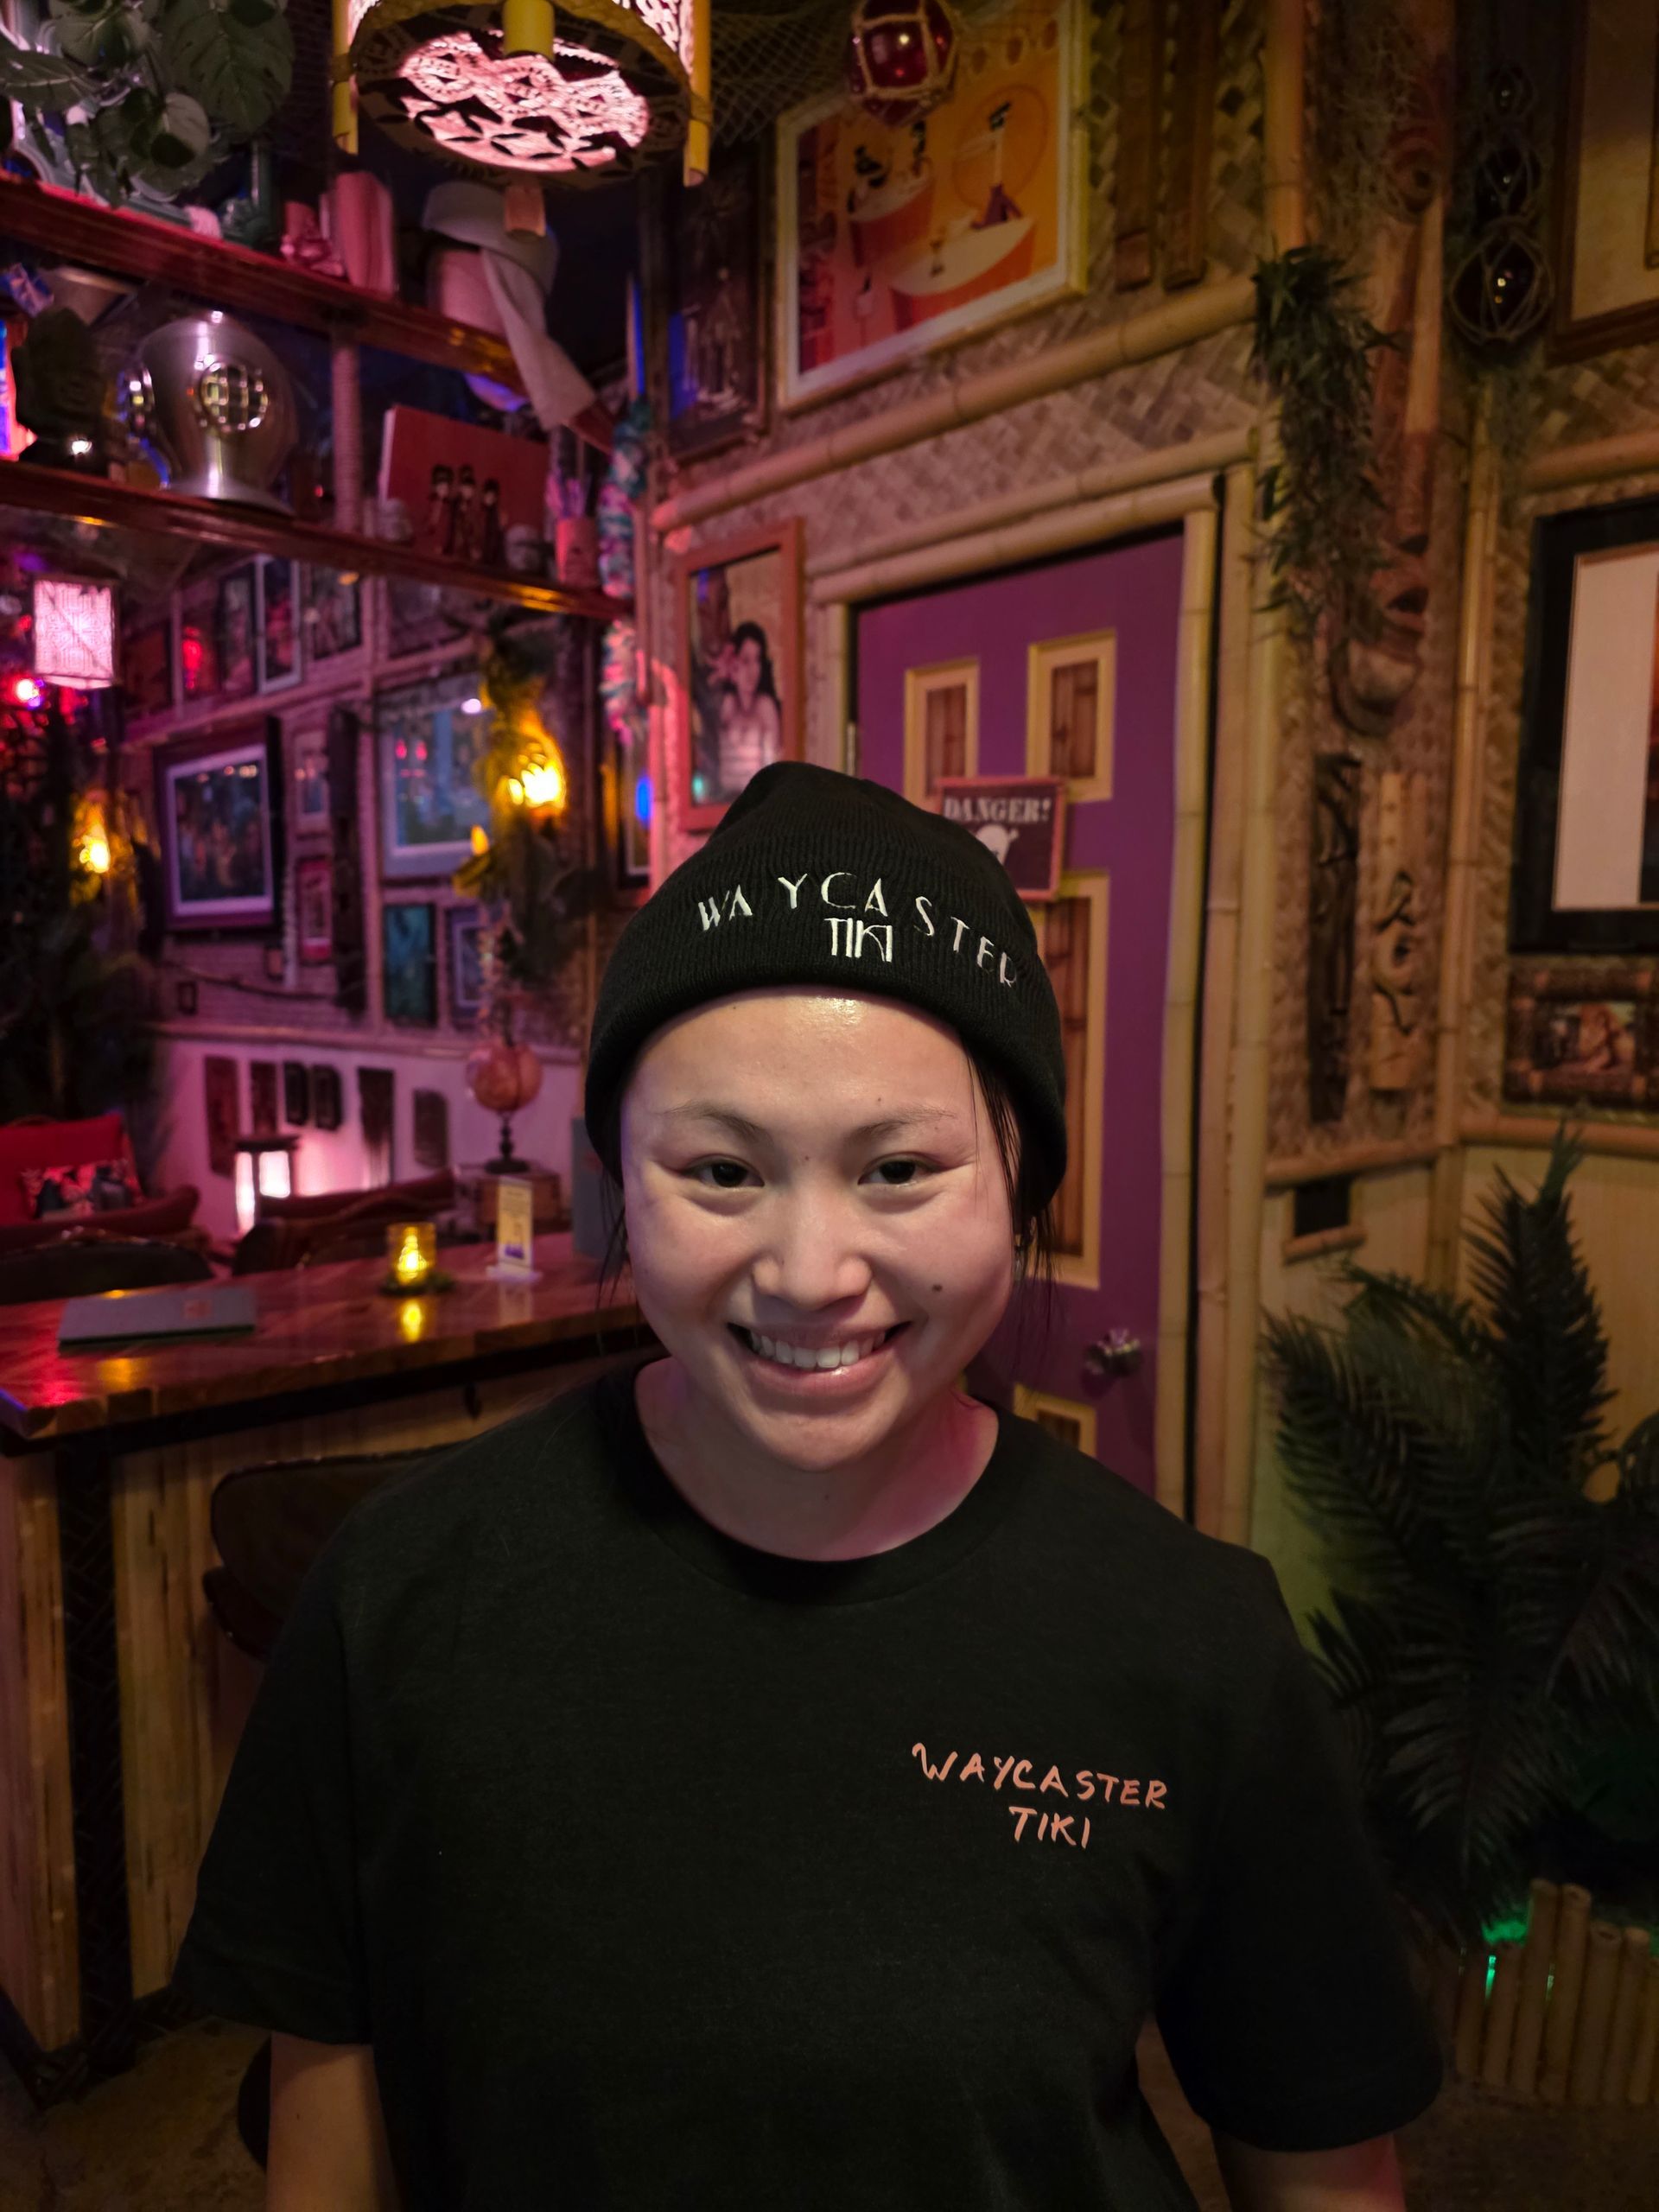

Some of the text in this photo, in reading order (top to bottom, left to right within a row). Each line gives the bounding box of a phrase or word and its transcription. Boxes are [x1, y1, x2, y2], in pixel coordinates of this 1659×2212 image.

[944, 796, 1052, 823] DANGER!
[823, 917, 894, 963] TIKI
[912, 1742, 1168, 1810] WAYCASTER
[1008, 1805, 1091, 1849] TIKI
